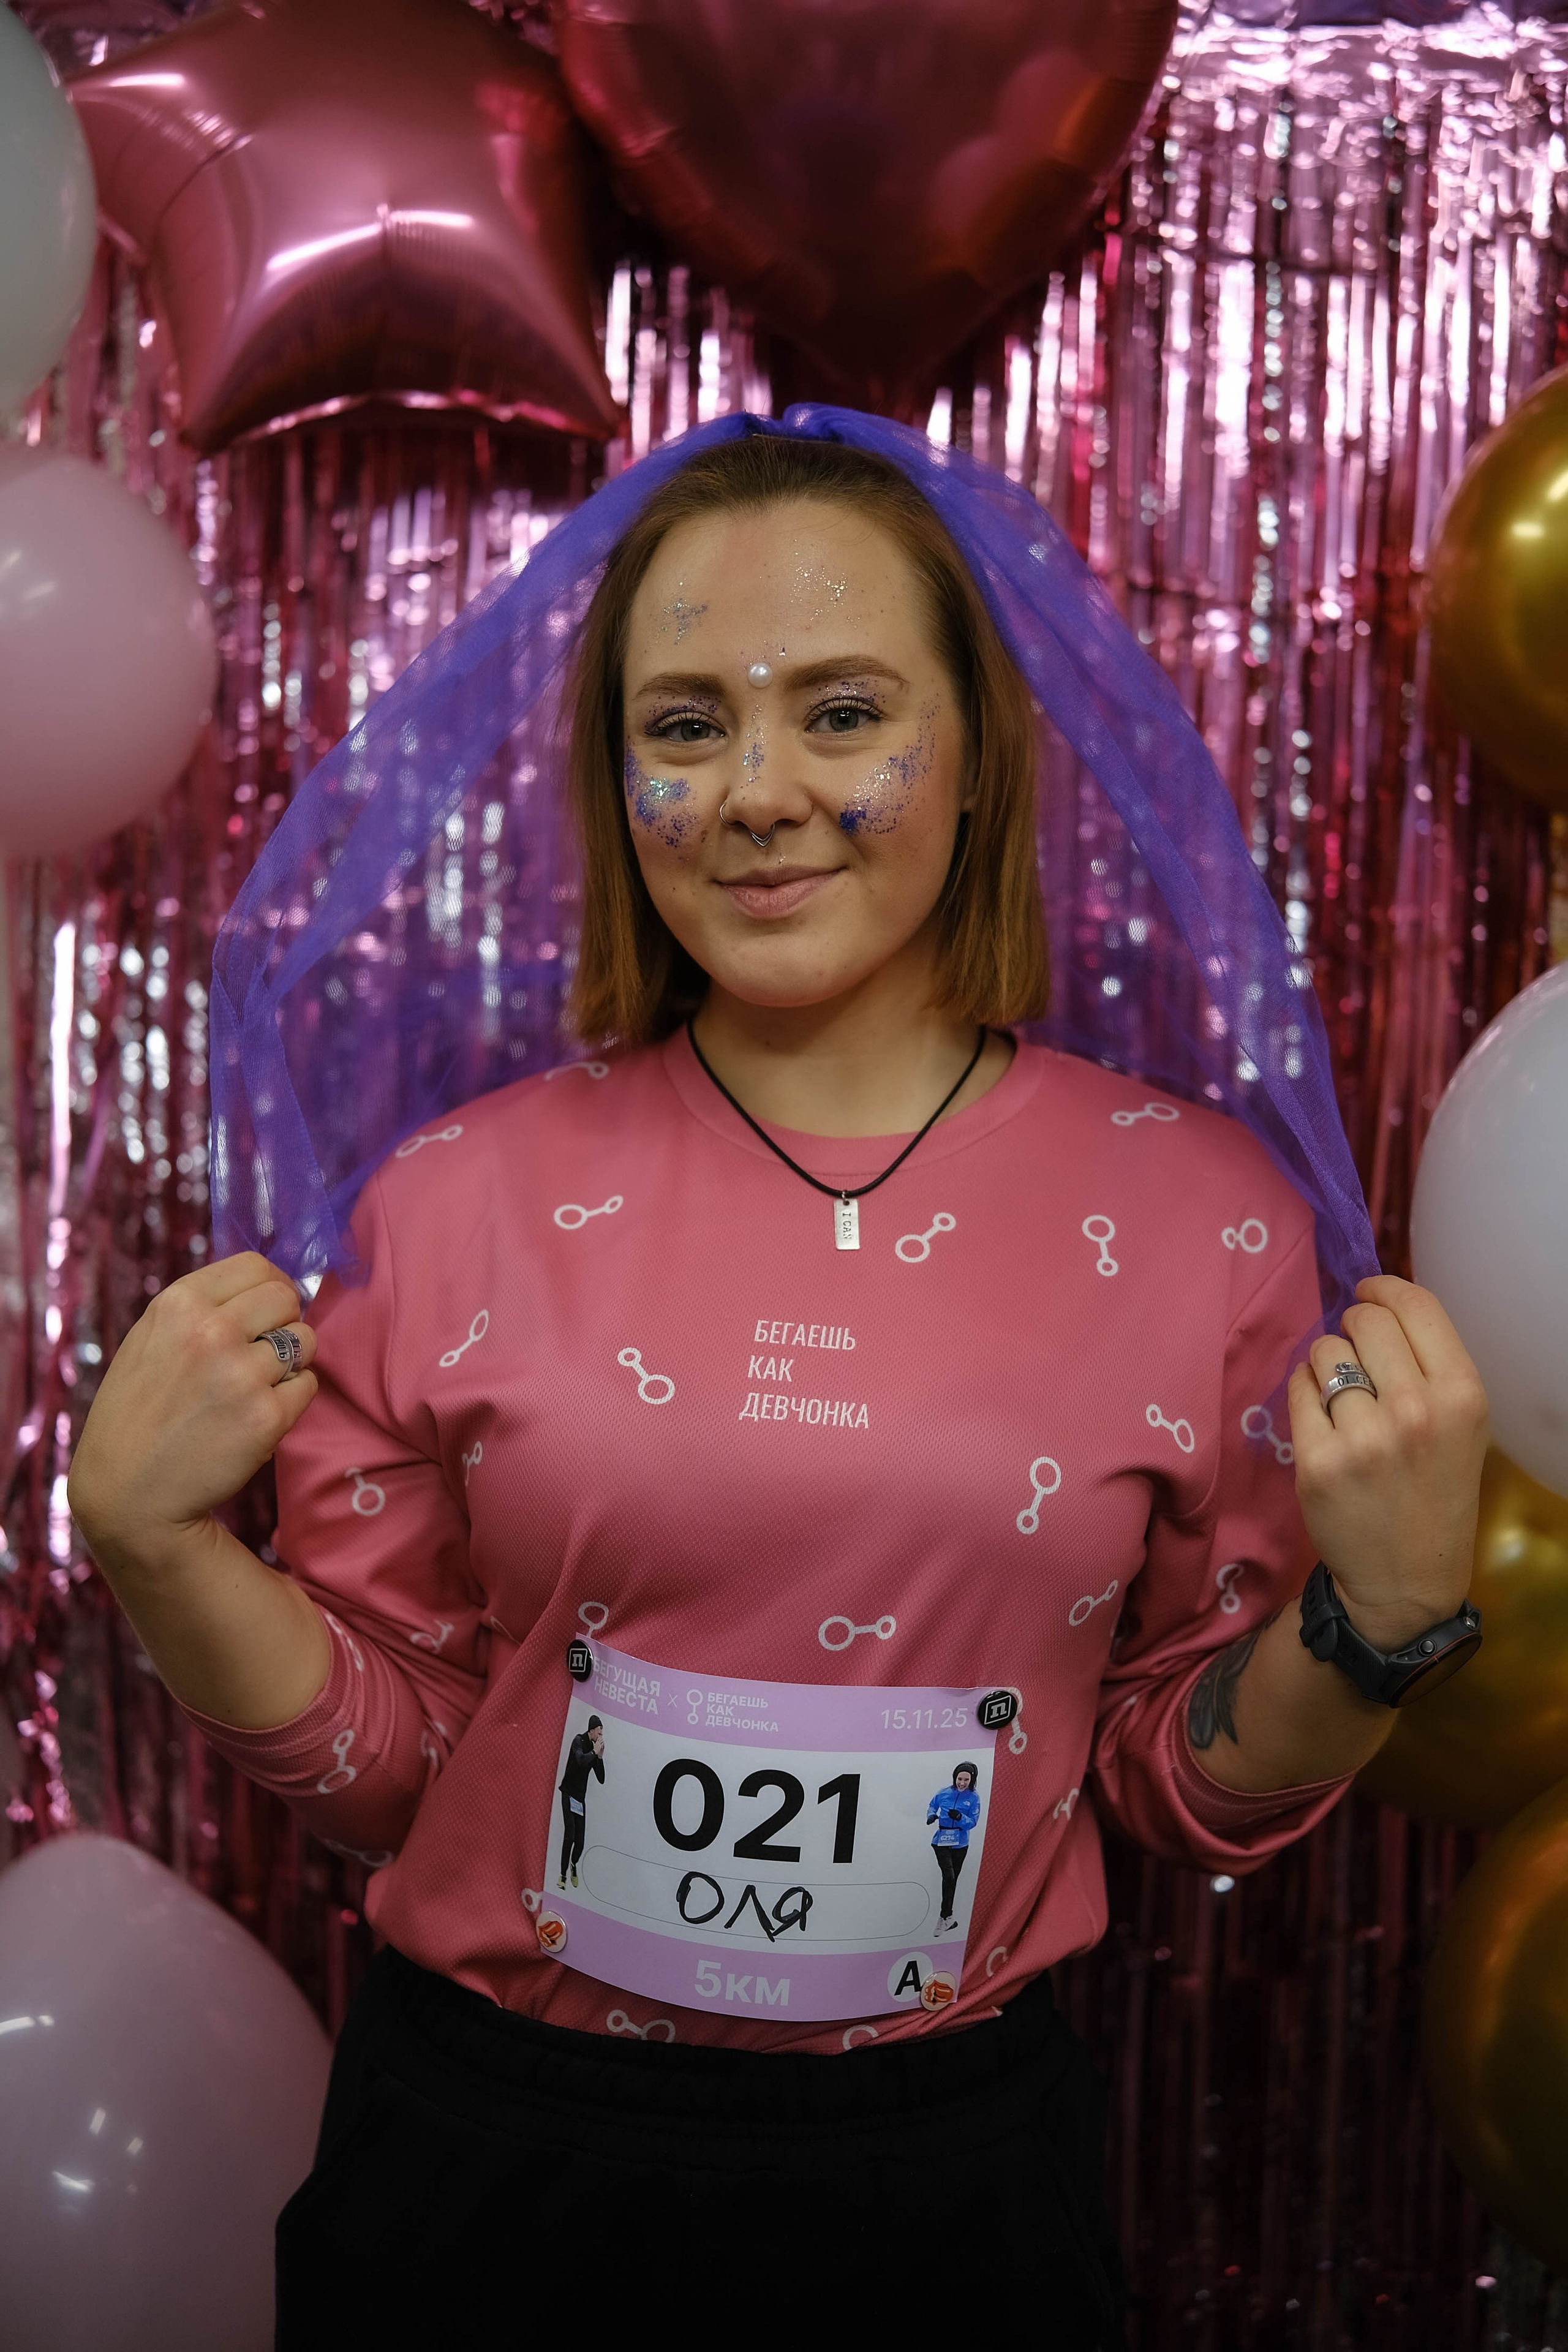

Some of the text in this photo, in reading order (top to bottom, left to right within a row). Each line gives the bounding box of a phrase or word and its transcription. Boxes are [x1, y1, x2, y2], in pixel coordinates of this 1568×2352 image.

[843, 1221, 852, 1239] CAN
[754, 1319, 856, 1351] БЕГАЕШЬ
[747, 1354, 794, 1382] КАК
[739, 1392, 870, 1429] ДЕВЧОНКА
[593, 1656, 661, 1697] БЕГУЩАЯ
[594, 1676, 660, 1715] НЕВЕСТА
[707, 1692, 769, 1709] БЕГАЕШЬ
[705, 1715, 779, 1733] ДЕВЧОНКА
[706, 1704, 734, 1716] КАК
[881, 1707, 968, 1730] 15.11.25
[653, 1758, 861, 1864] 021
